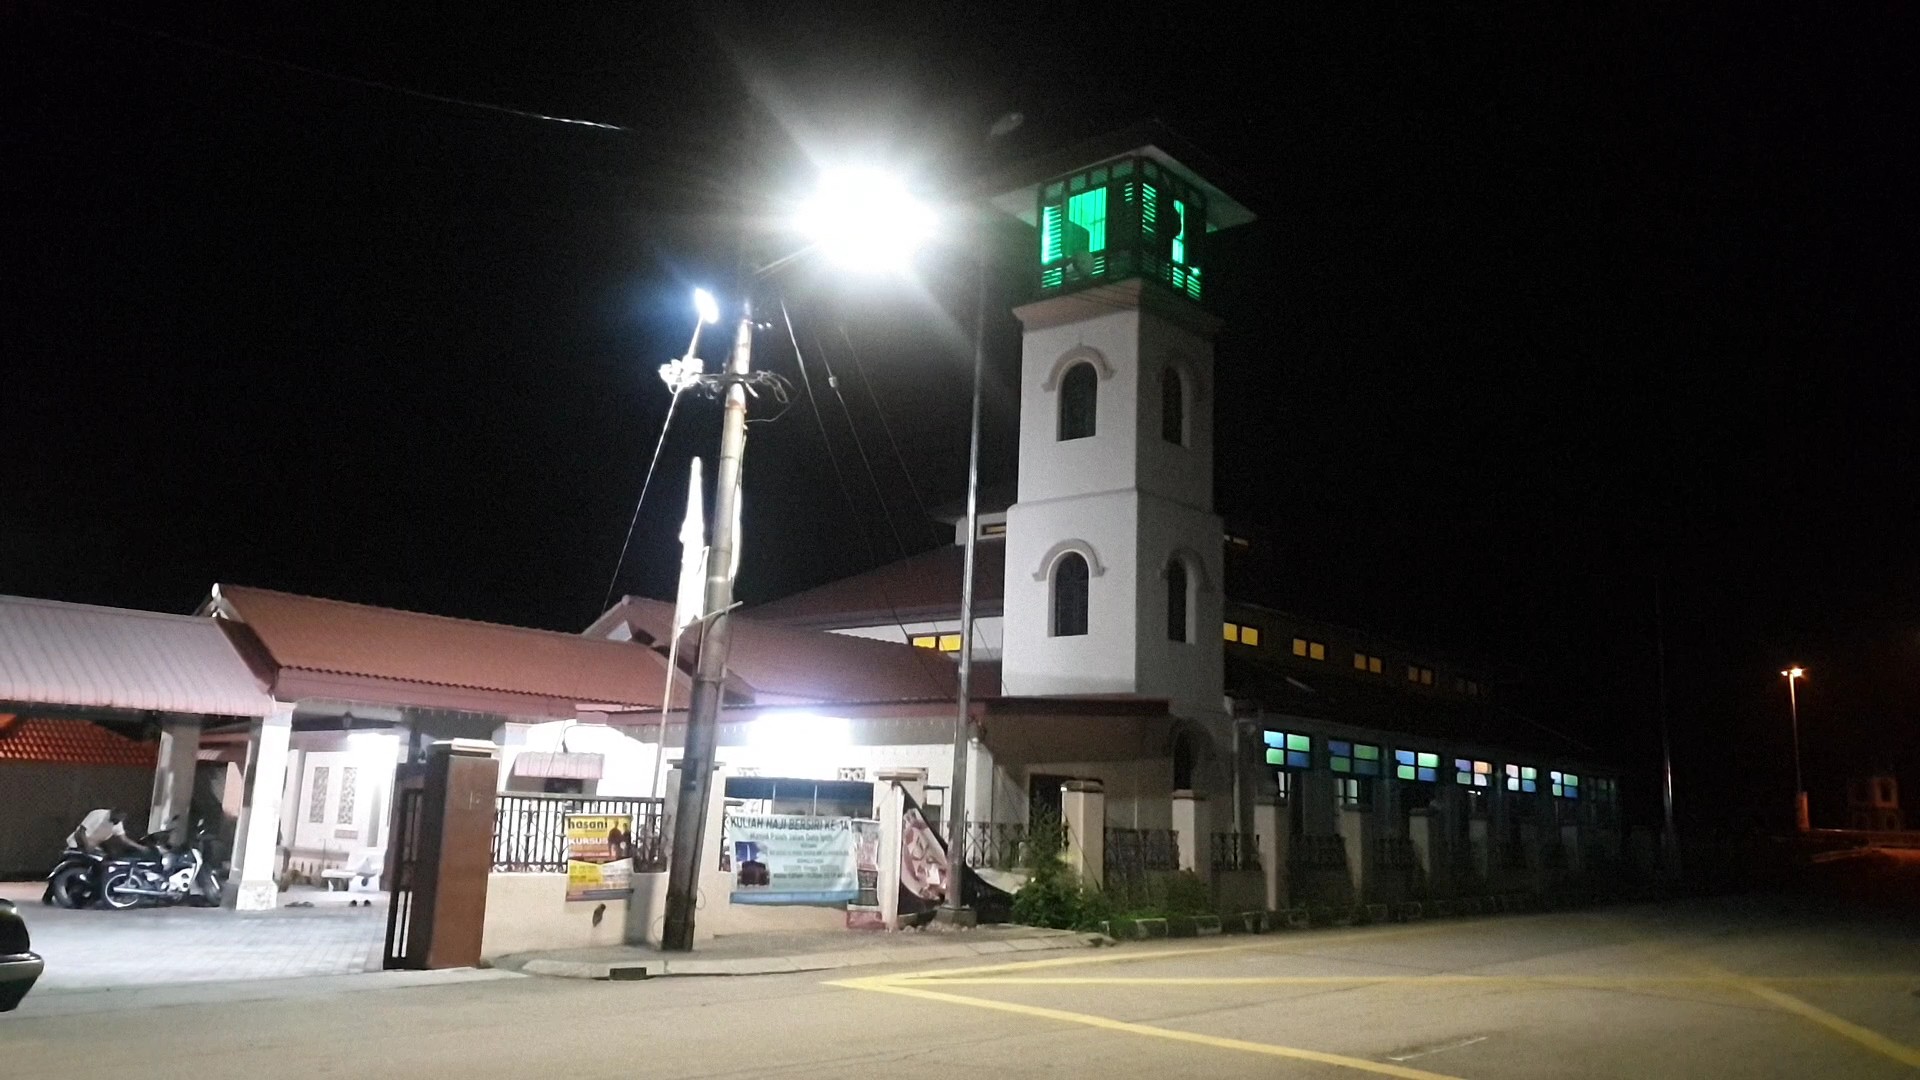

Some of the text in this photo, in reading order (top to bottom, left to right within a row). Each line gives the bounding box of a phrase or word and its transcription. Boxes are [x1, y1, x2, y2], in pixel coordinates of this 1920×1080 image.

[568, 818, 607, 829] hasani
[730, 816, 763, 829] KULIAH
[766, 818, 786, 830] HAJI
[788, 818, 822, 830] BERSIRI
[569, 837, 608, 845] KURSUS
